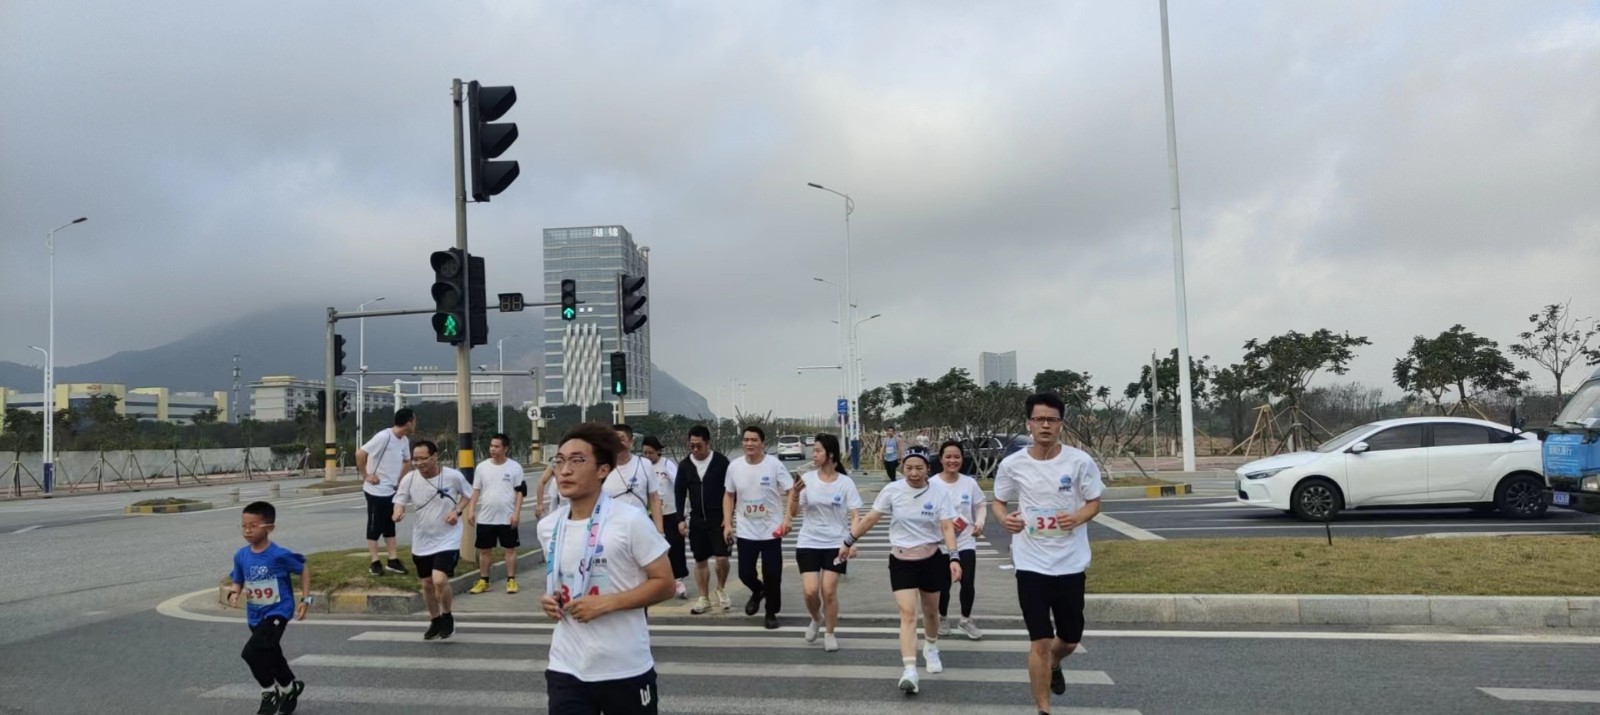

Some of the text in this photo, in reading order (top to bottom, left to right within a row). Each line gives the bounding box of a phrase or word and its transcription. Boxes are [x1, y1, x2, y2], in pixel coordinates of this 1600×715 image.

[746, 504, 765, 513] 076
[1036, 516, 1057, 530] 32
[246, 587, 273, 599] 299
